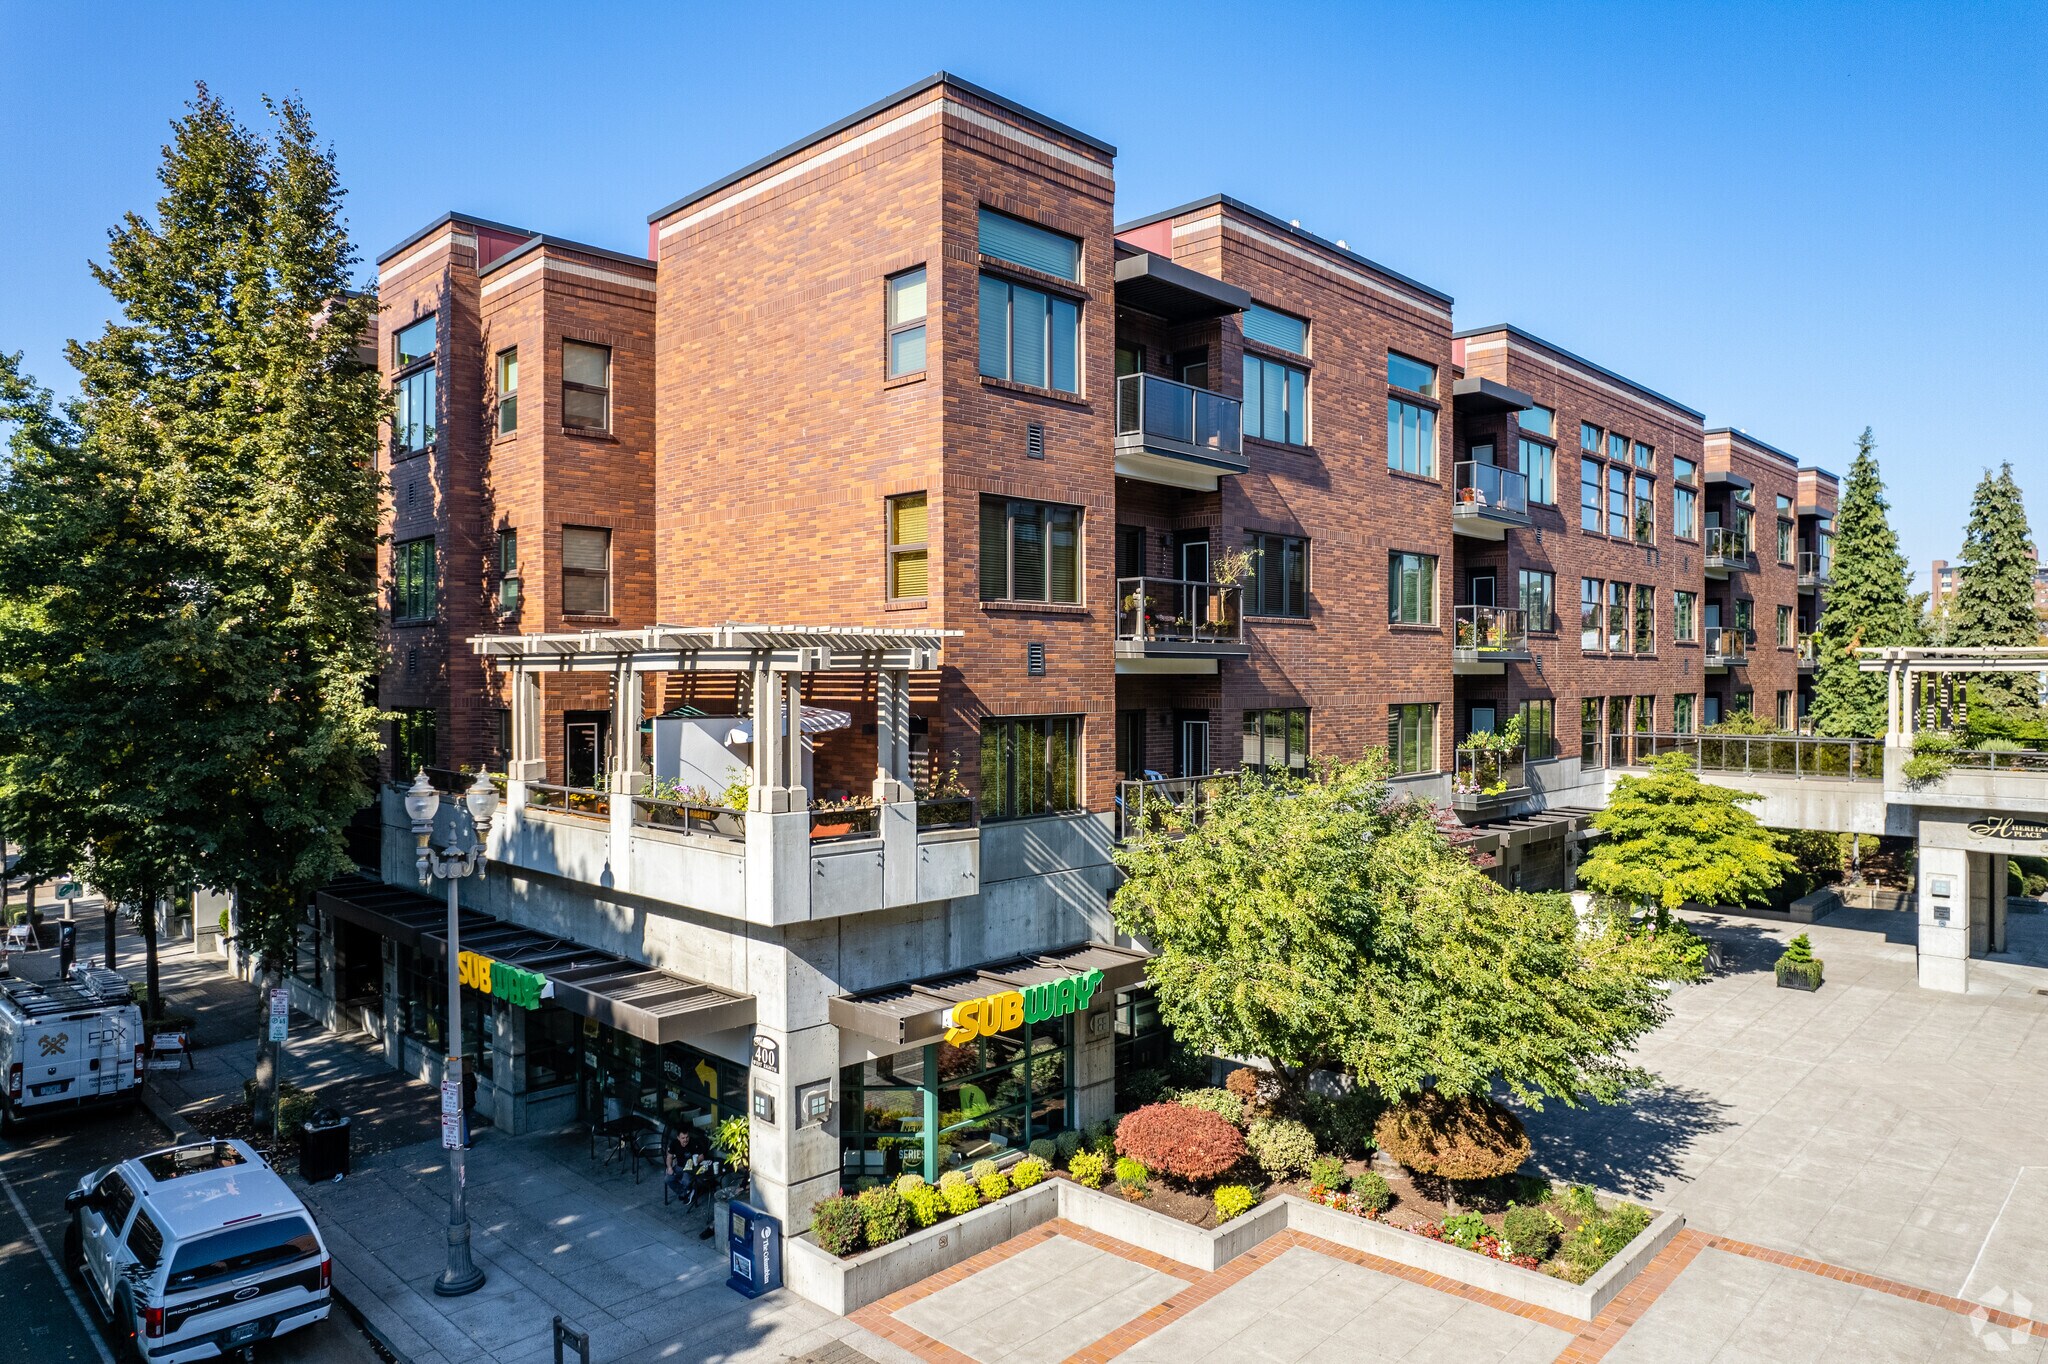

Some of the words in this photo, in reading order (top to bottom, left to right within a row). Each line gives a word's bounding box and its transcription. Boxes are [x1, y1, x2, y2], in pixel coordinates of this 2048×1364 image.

[458, 951, 546, 1010] SUBWAY
[944, 967, 1104, 1048] SUBWAY
[88, 1027, 126, 1044] FDX
[755, 1046, 775, 1066] 400
[663, 1061, 681, 1078] SERIES
[763, 1251, 771, 1285] Columbian
[167, 1299, 219, 1316] ROUSH
